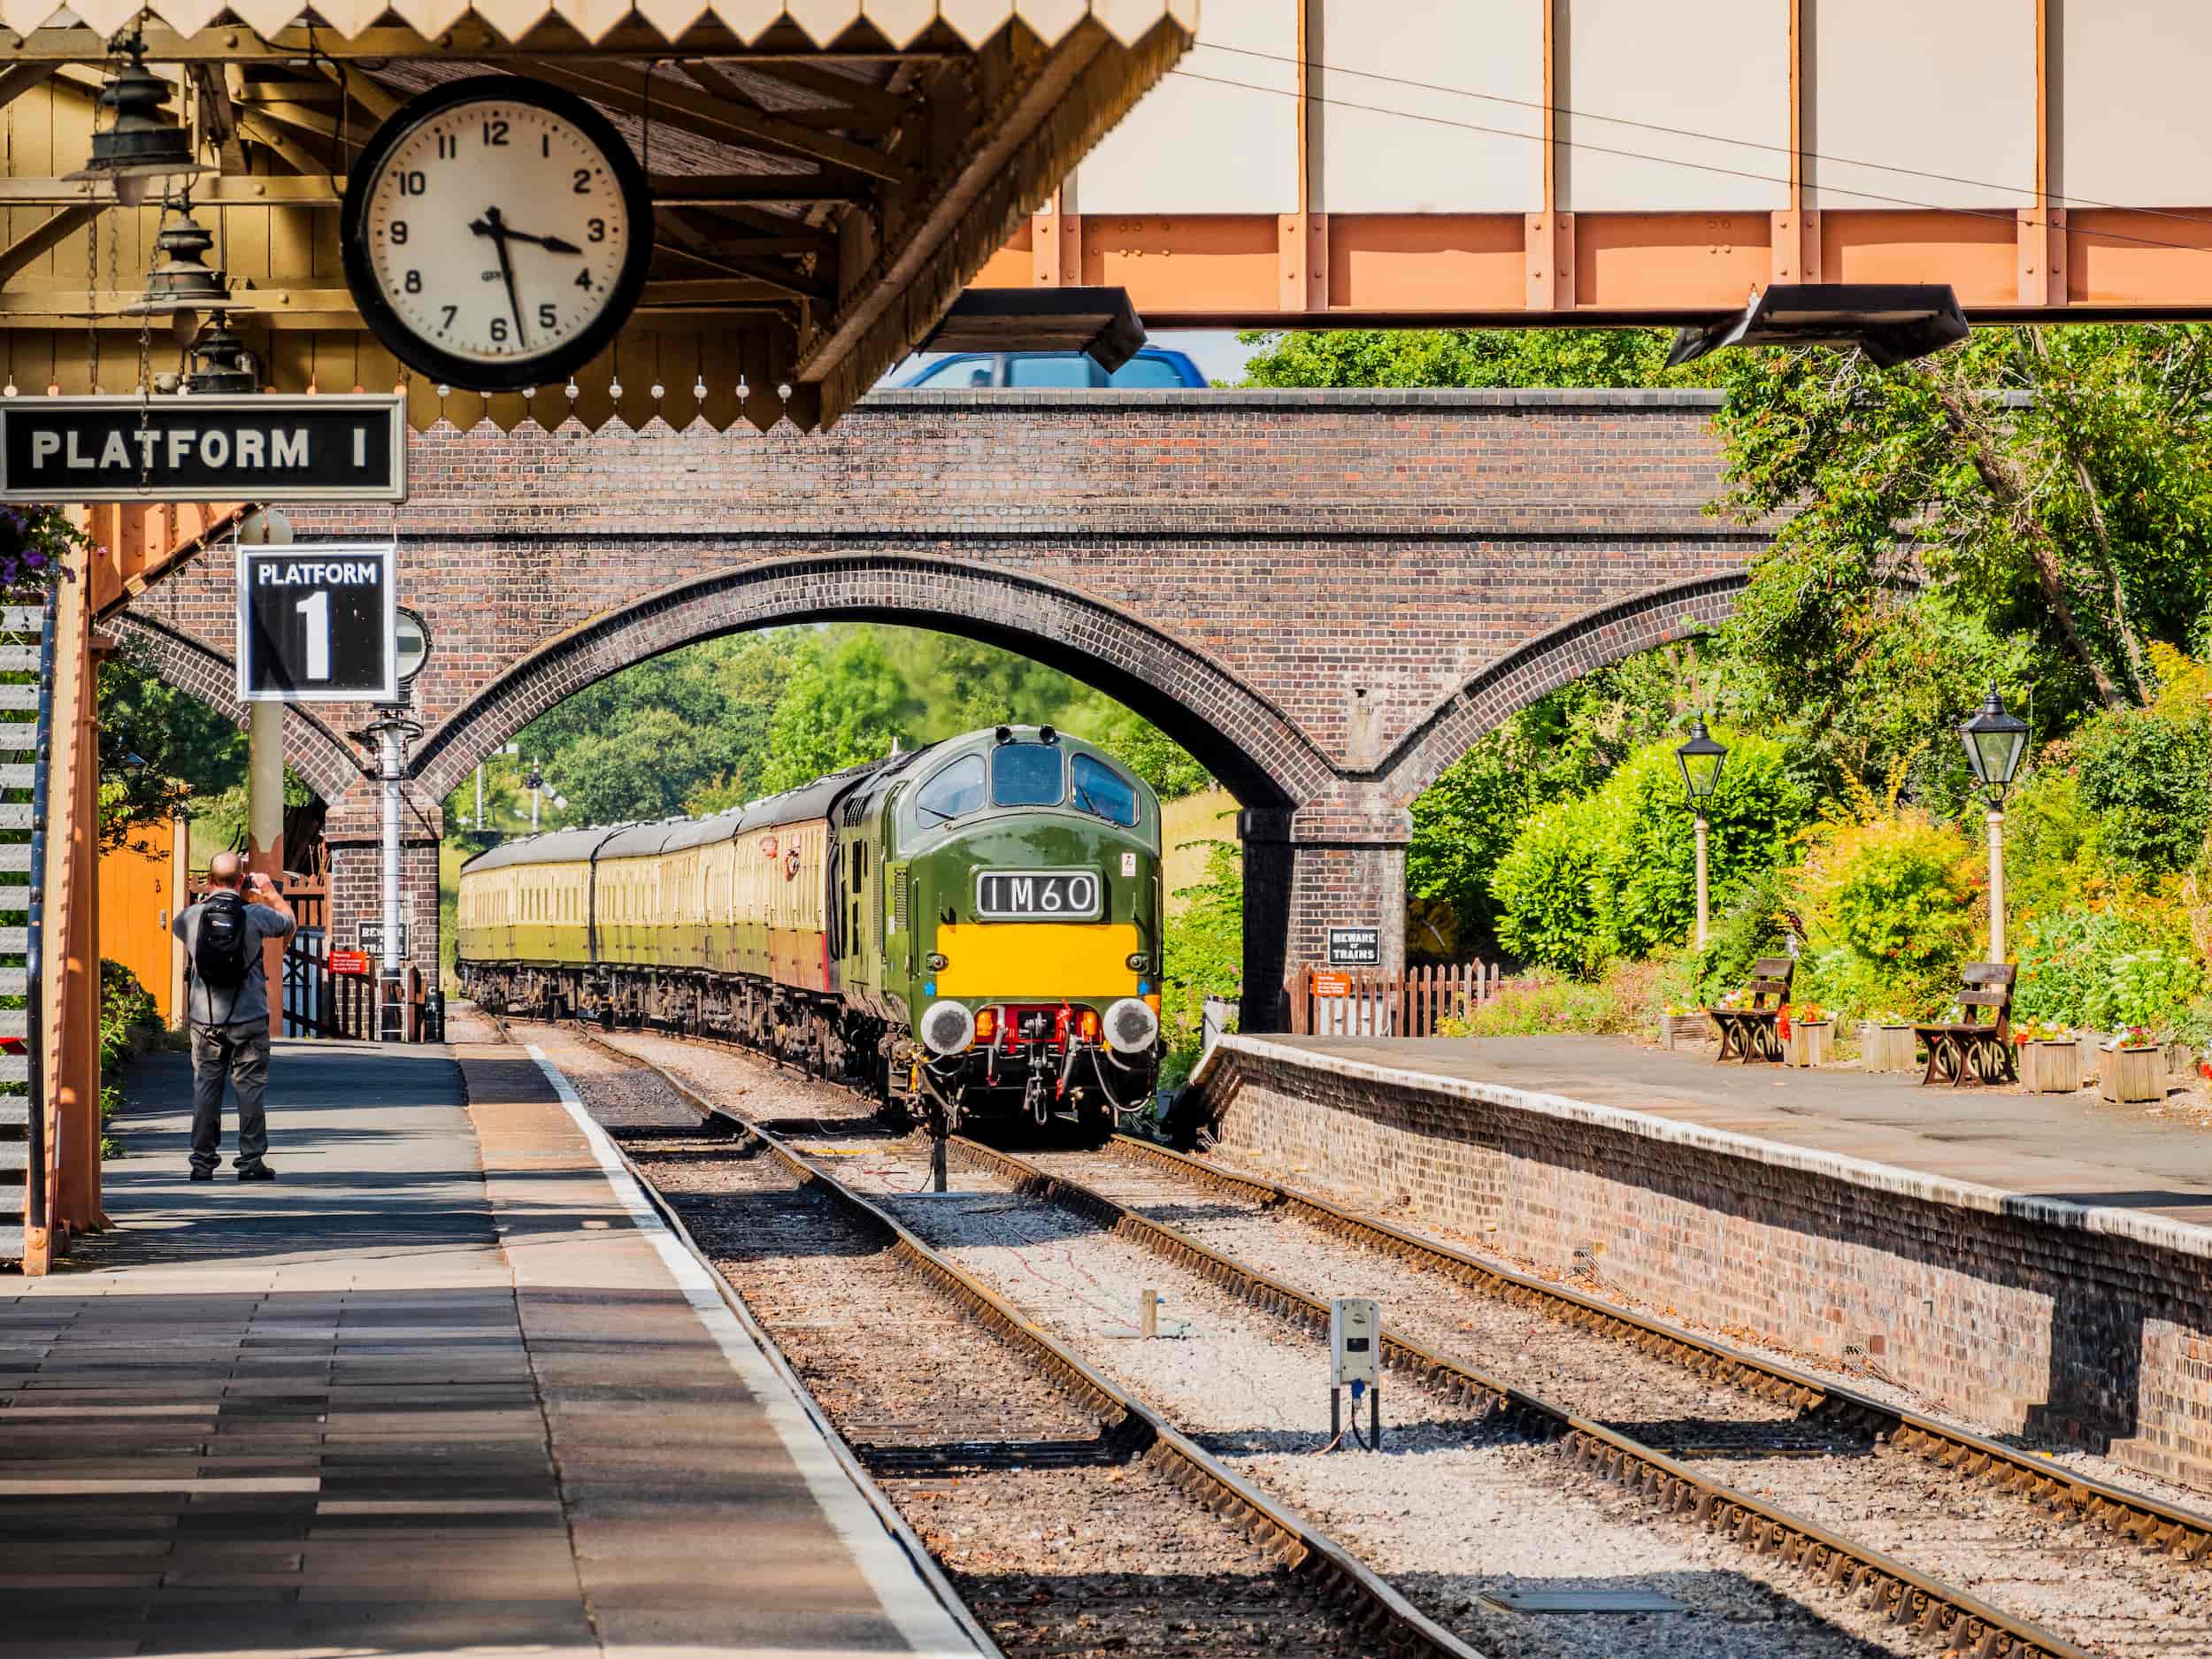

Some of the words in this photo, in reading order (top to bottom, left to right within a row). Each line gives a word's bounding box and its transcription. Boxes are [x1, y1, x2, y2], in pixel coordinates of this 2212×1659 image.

[483, 121, 509, 146] 12
[437, 134, 456, 159] 11
[541, 134, 549, 158] 1
[399, 171, 426, 196] 10
[572, 169, 591, 194] 2
[390, 221, 408, 244] 9
[587, 219, 605, 242] 3
[404, 270, 422, 294] 8
[574, 268, 593, 292] 4
[441, 305, 458, 329] 7
[539, 304, 557, 328] 5
[490, 319, 508, 342] 6
[32, 429, 309, 469] PLATFORM
[258, 563, 377, 585] PLATFORM
[296, 590, 330, 680] 1
[361, 927, 404, 938] BEWE
[1333, 933, 1376, 943] BEWARE
[1333, 949, 1375, 959] TRAINS
[1967, 1040, 2008, 1080] GWR
